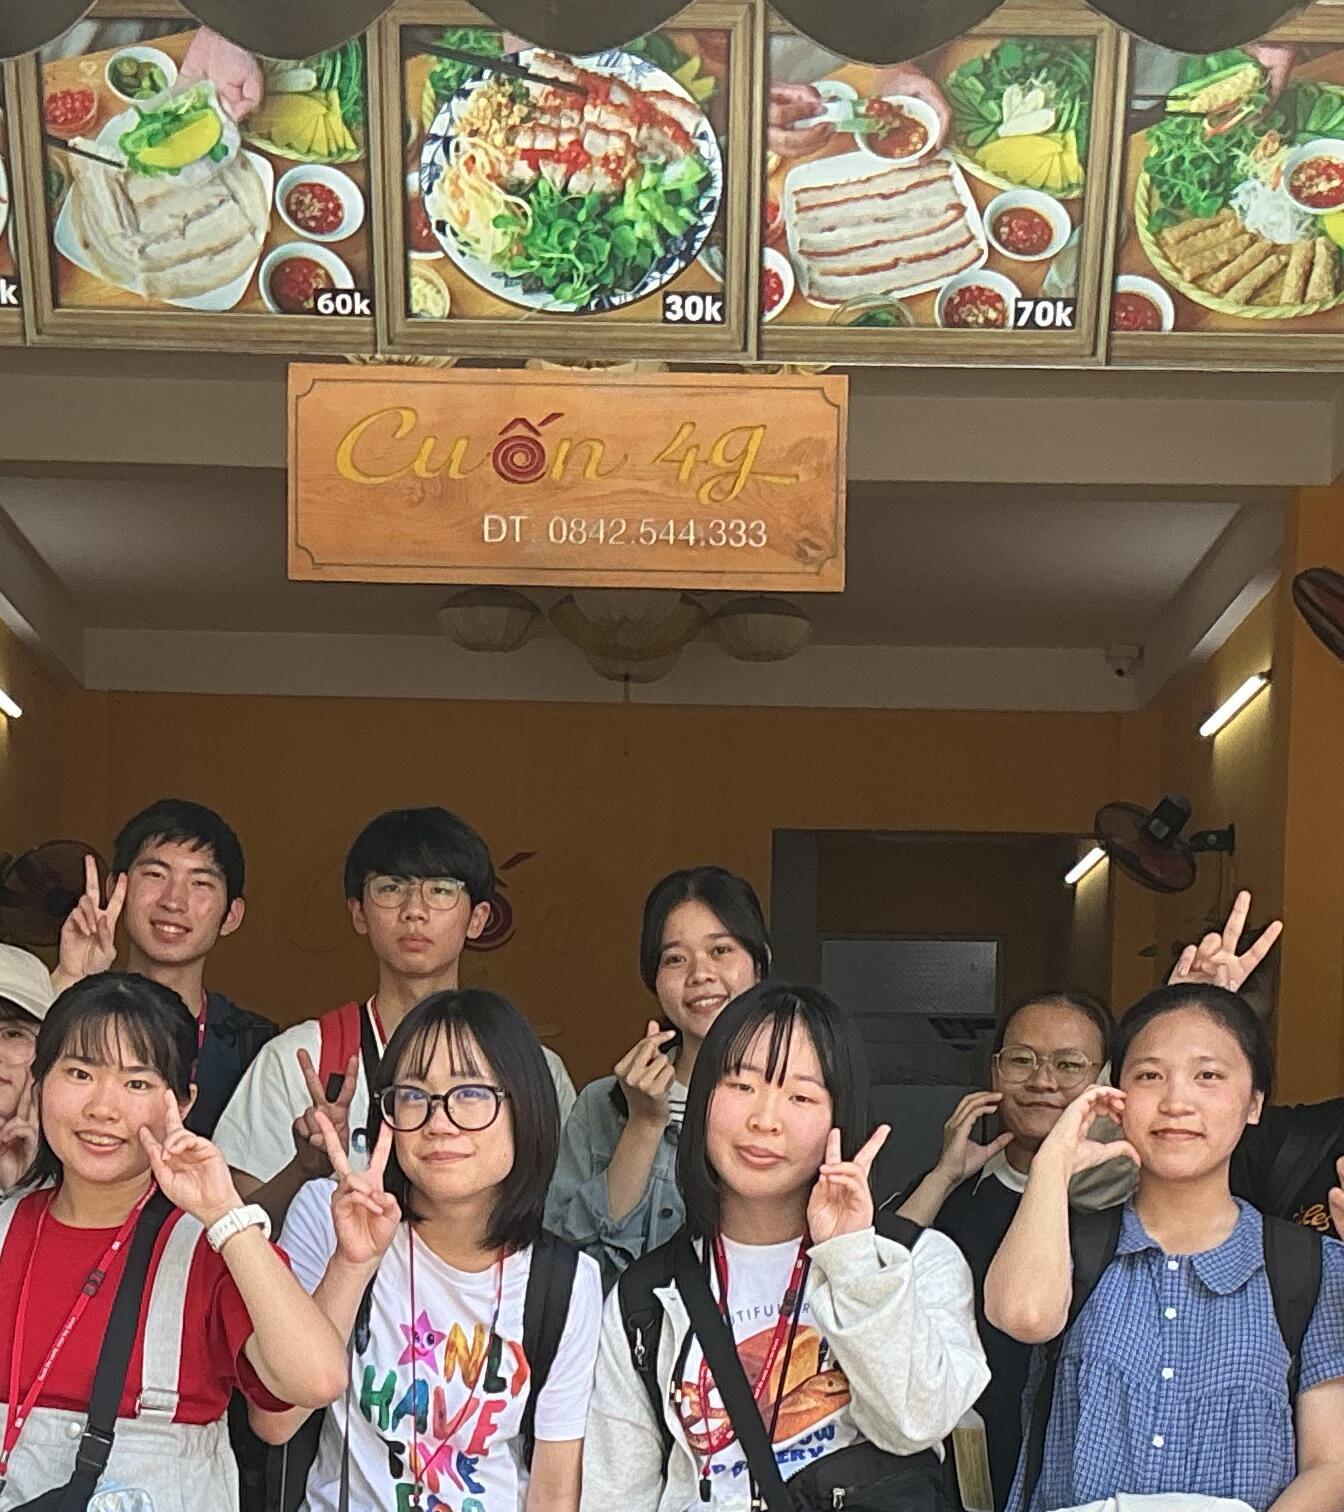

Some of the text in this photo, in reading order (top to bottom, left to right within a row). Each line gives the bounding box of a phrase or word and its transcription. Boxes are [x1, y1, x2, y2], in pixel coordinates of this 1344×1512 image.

[315, 291, 371, 316] 60k
[665, 295, 722, 322] 30k
[1016, 298, 1073, 327] 70k
[335, 406, 799, 504] Cuốn 4g
[549, 516, 767, 548] 0842.544.333
